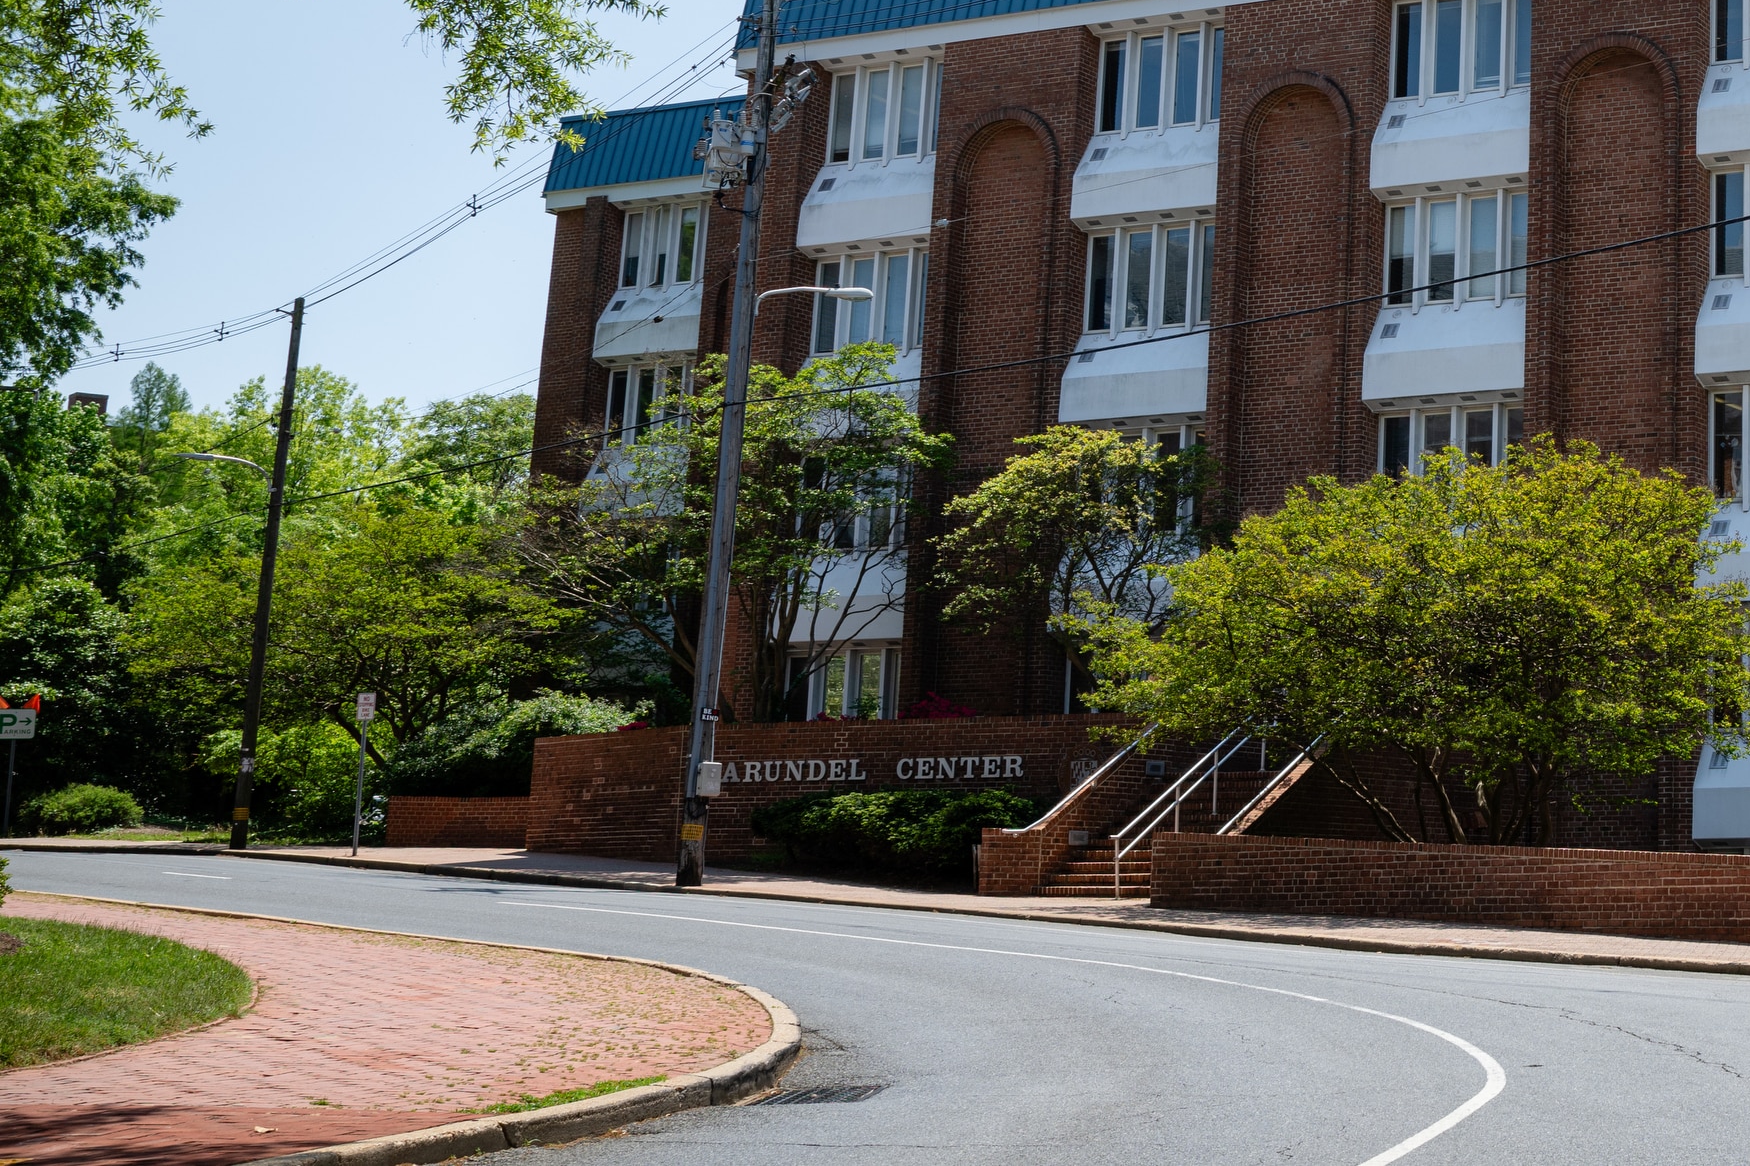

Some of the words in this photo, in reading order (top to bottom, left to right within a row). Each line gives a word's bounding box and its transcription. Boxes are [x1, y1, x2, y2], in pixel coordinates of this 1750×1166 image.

[701, 714, 719, 722] KIND
[721, 758, 866, 783] ARUNDEL
[896, 755, 1024, 780] CENTER
